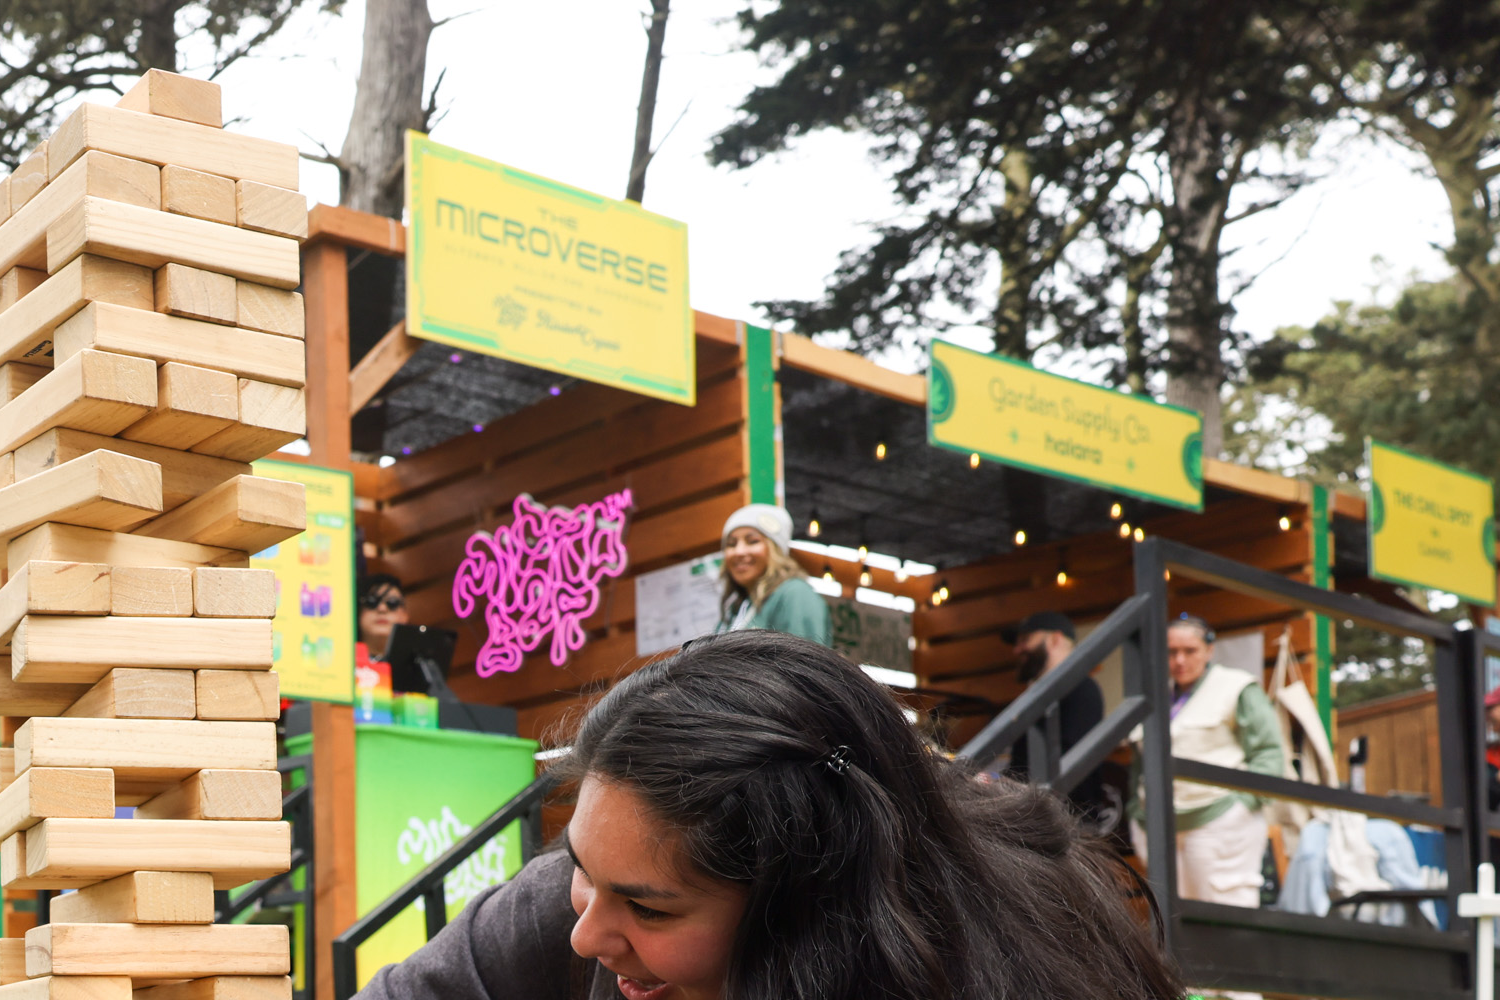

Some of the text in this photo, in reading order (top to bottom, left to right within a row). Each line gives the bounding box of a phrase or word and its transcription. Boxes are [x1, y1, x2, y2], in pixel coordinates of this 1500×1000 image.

[538, 207, 579, 231] THE
[436, 198, 668, 294] MICROVERSE
[1062, 396, 1122, 443] Supply
